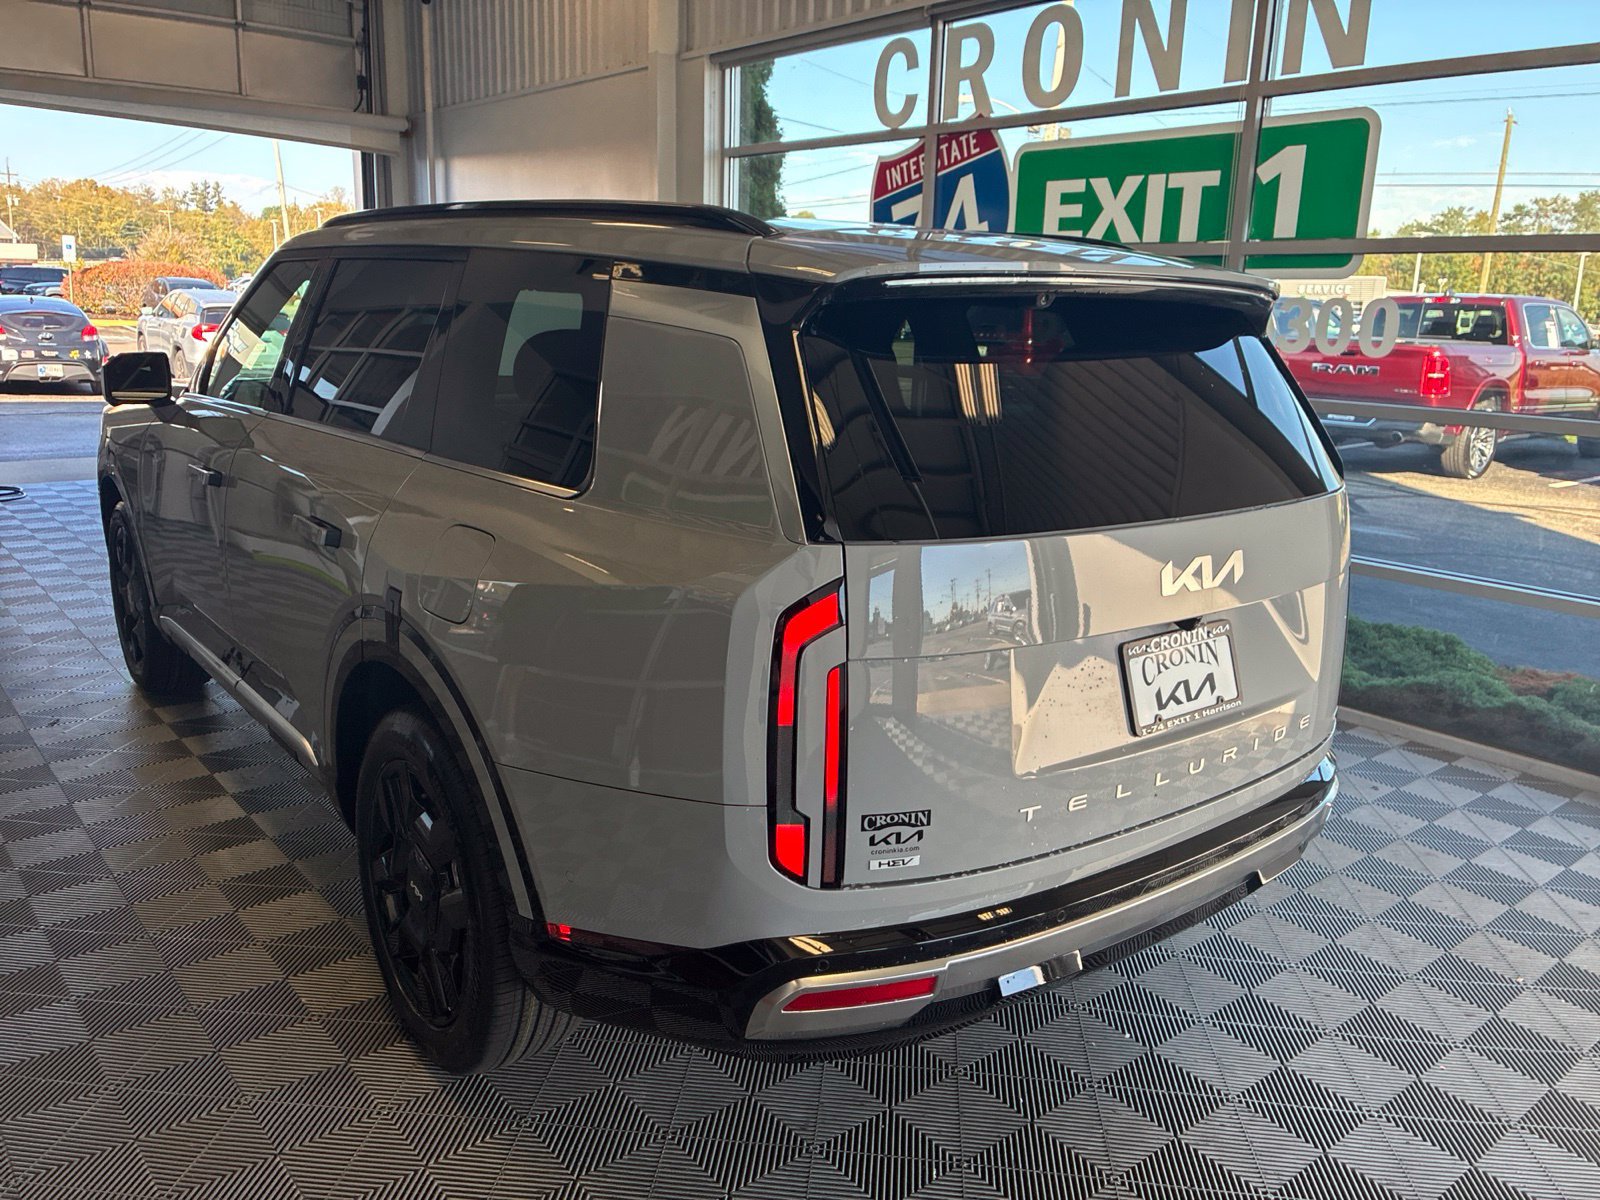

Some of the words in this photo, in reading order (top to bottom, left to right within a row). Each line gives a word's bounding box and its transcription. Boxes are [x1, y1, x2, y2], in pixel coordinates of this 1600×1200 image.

[873, 0, 1371, 129] CRONIN
[885, 131, 981, 191] INTETATE
[1043, 169, 1222, 244] EXIT
[1256, 144, 1308, 240] 1
[1297, 284, 1353, 296] SERVICE
[1311, 362, 1380, 377] RAM
[1160, 549, 1245, 597] KIA
[1150, 626, 1209, 653] CRONIN
[1141, 639, 1220, 687] CRONIN
[1155, 672, 1217, 711] KIA
[1141, 723, 1165, 736] I-74
[1167, 716, 1191, 728] EXIT
[1194, 711, 1201, 720] 1
[1203, 701, 1242, 717] Harrison
[1019, 714, 1311, 823] TELLURIDE
[863, 811, 930, 831] CRONIN
[869, 829, 924, 847] KIA
[871, 846, 920, 855] croninkia.com
[878, 858, 914, 868] HEV
